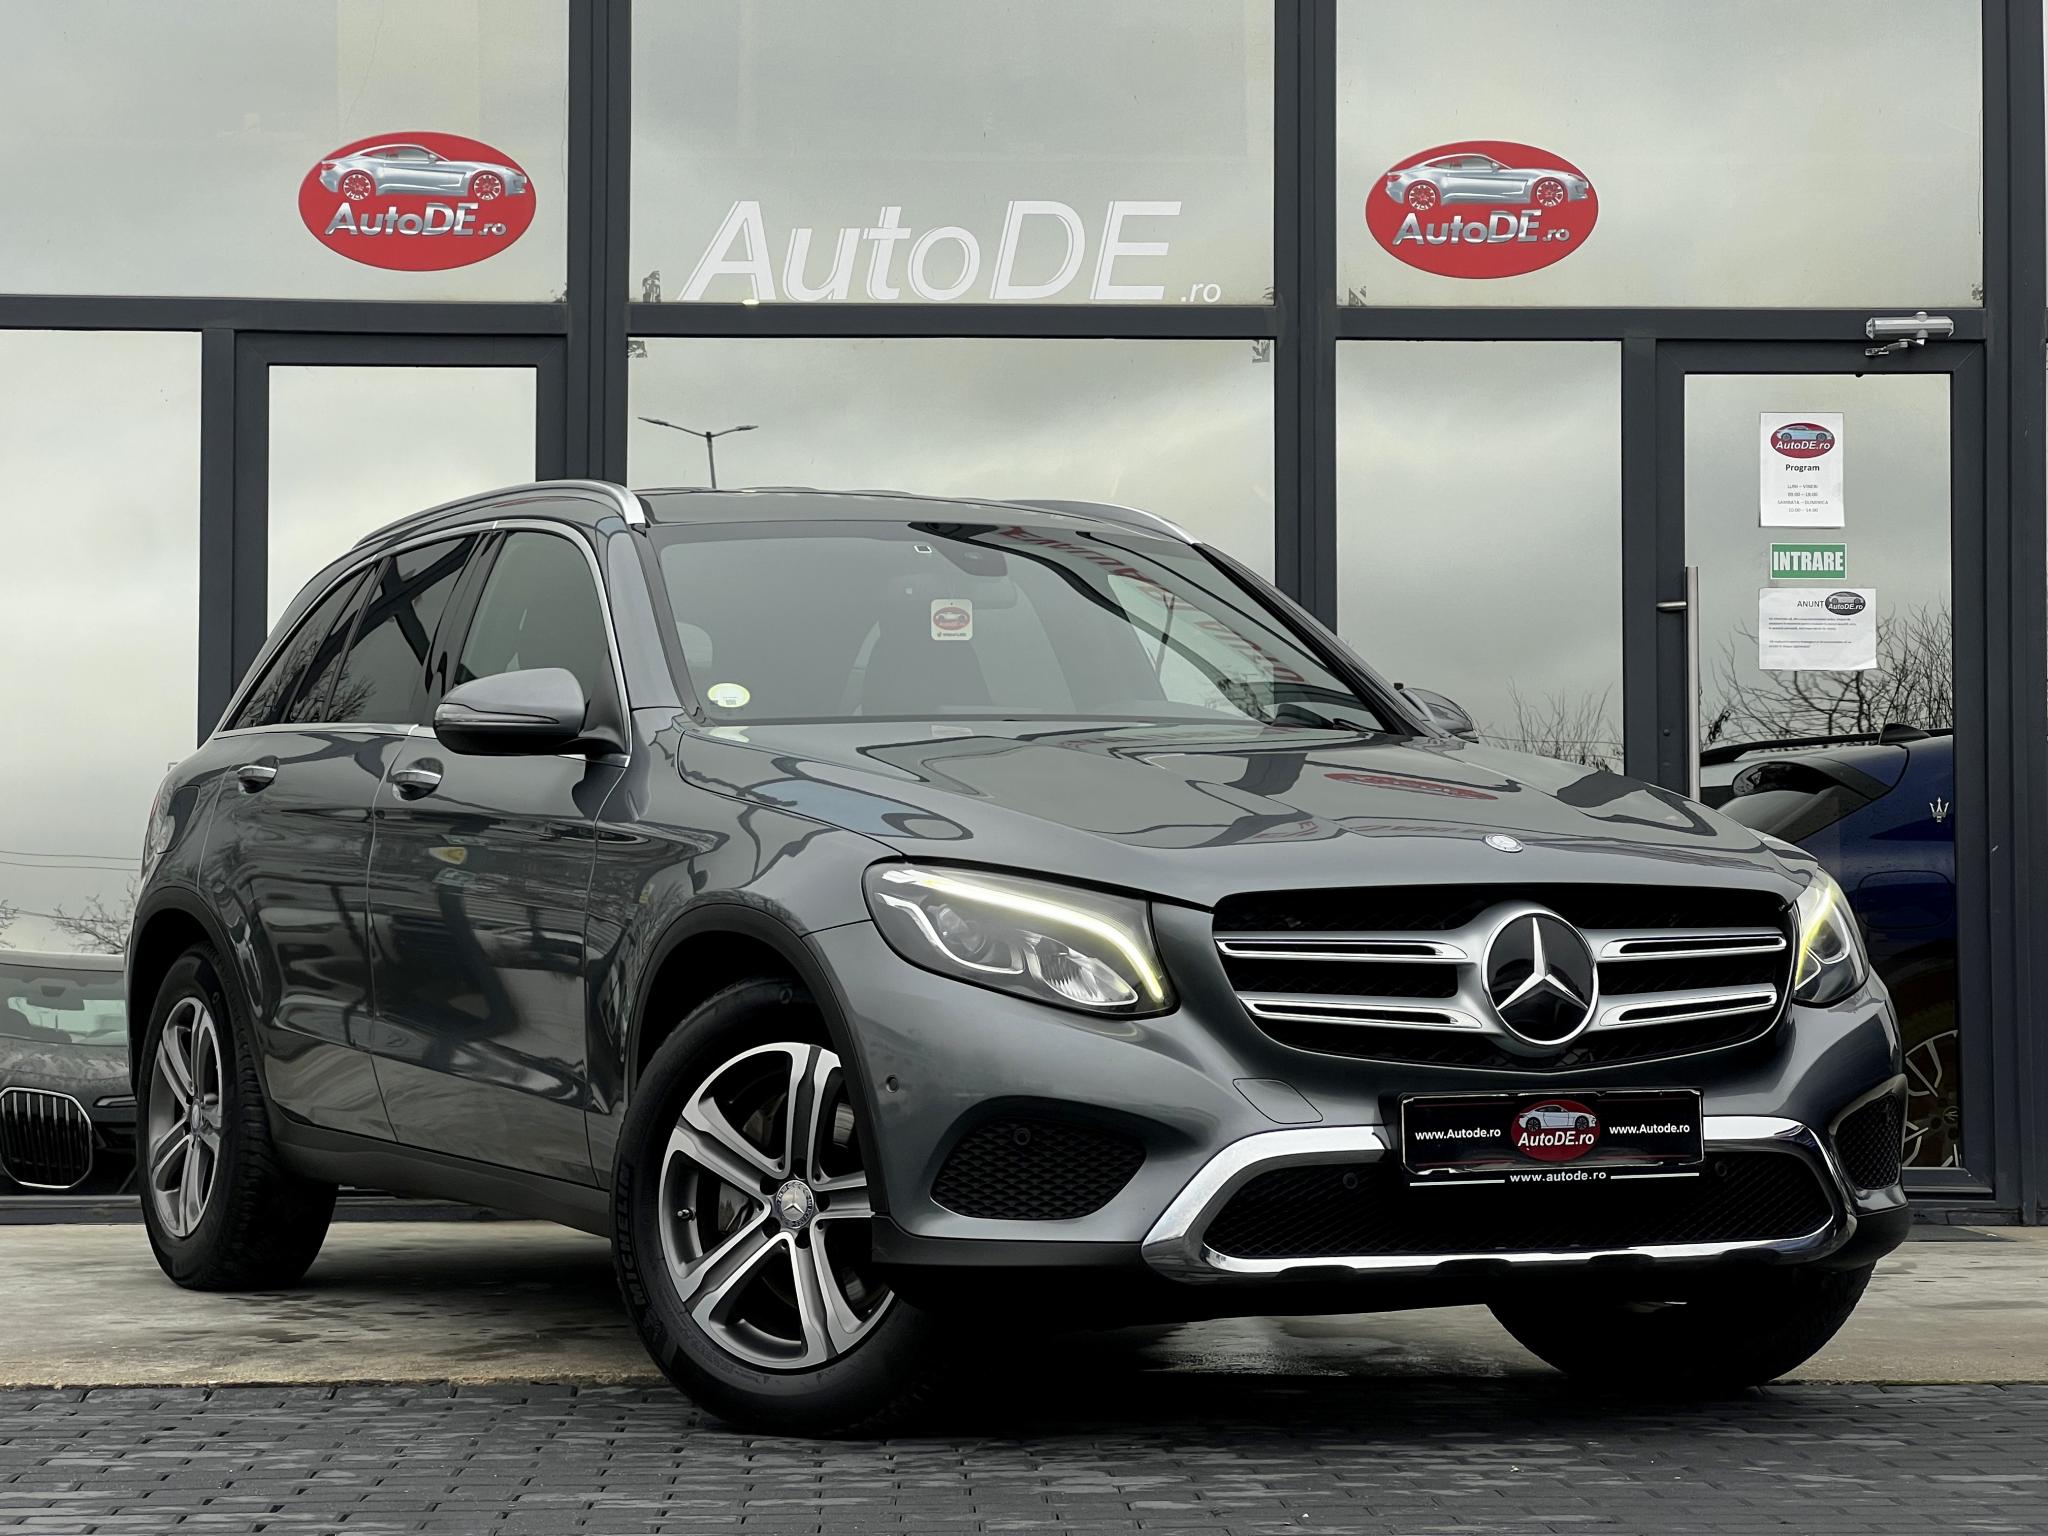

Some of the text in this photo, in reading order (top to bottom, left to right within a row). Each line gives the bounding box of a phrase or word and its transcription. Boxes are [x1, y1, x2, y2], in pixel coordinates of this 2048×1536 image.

[1775, 440, 1831, 450] AutoDE.ro
[1785, 463, 1820, 473] Program
[1773, 551, 1844, 571] INTRARE
[1415, 1127, 1502, 1141] www.Autode.ro
[1609, 1122, 1691, 1135] www.Autode.ro
[1517, 1131, 1595, 1147] AutoDE.ro
[1509, 1170, 1607, 1183] www.autode.ro
[617, 1163, 648, 1307] MICHELIN
